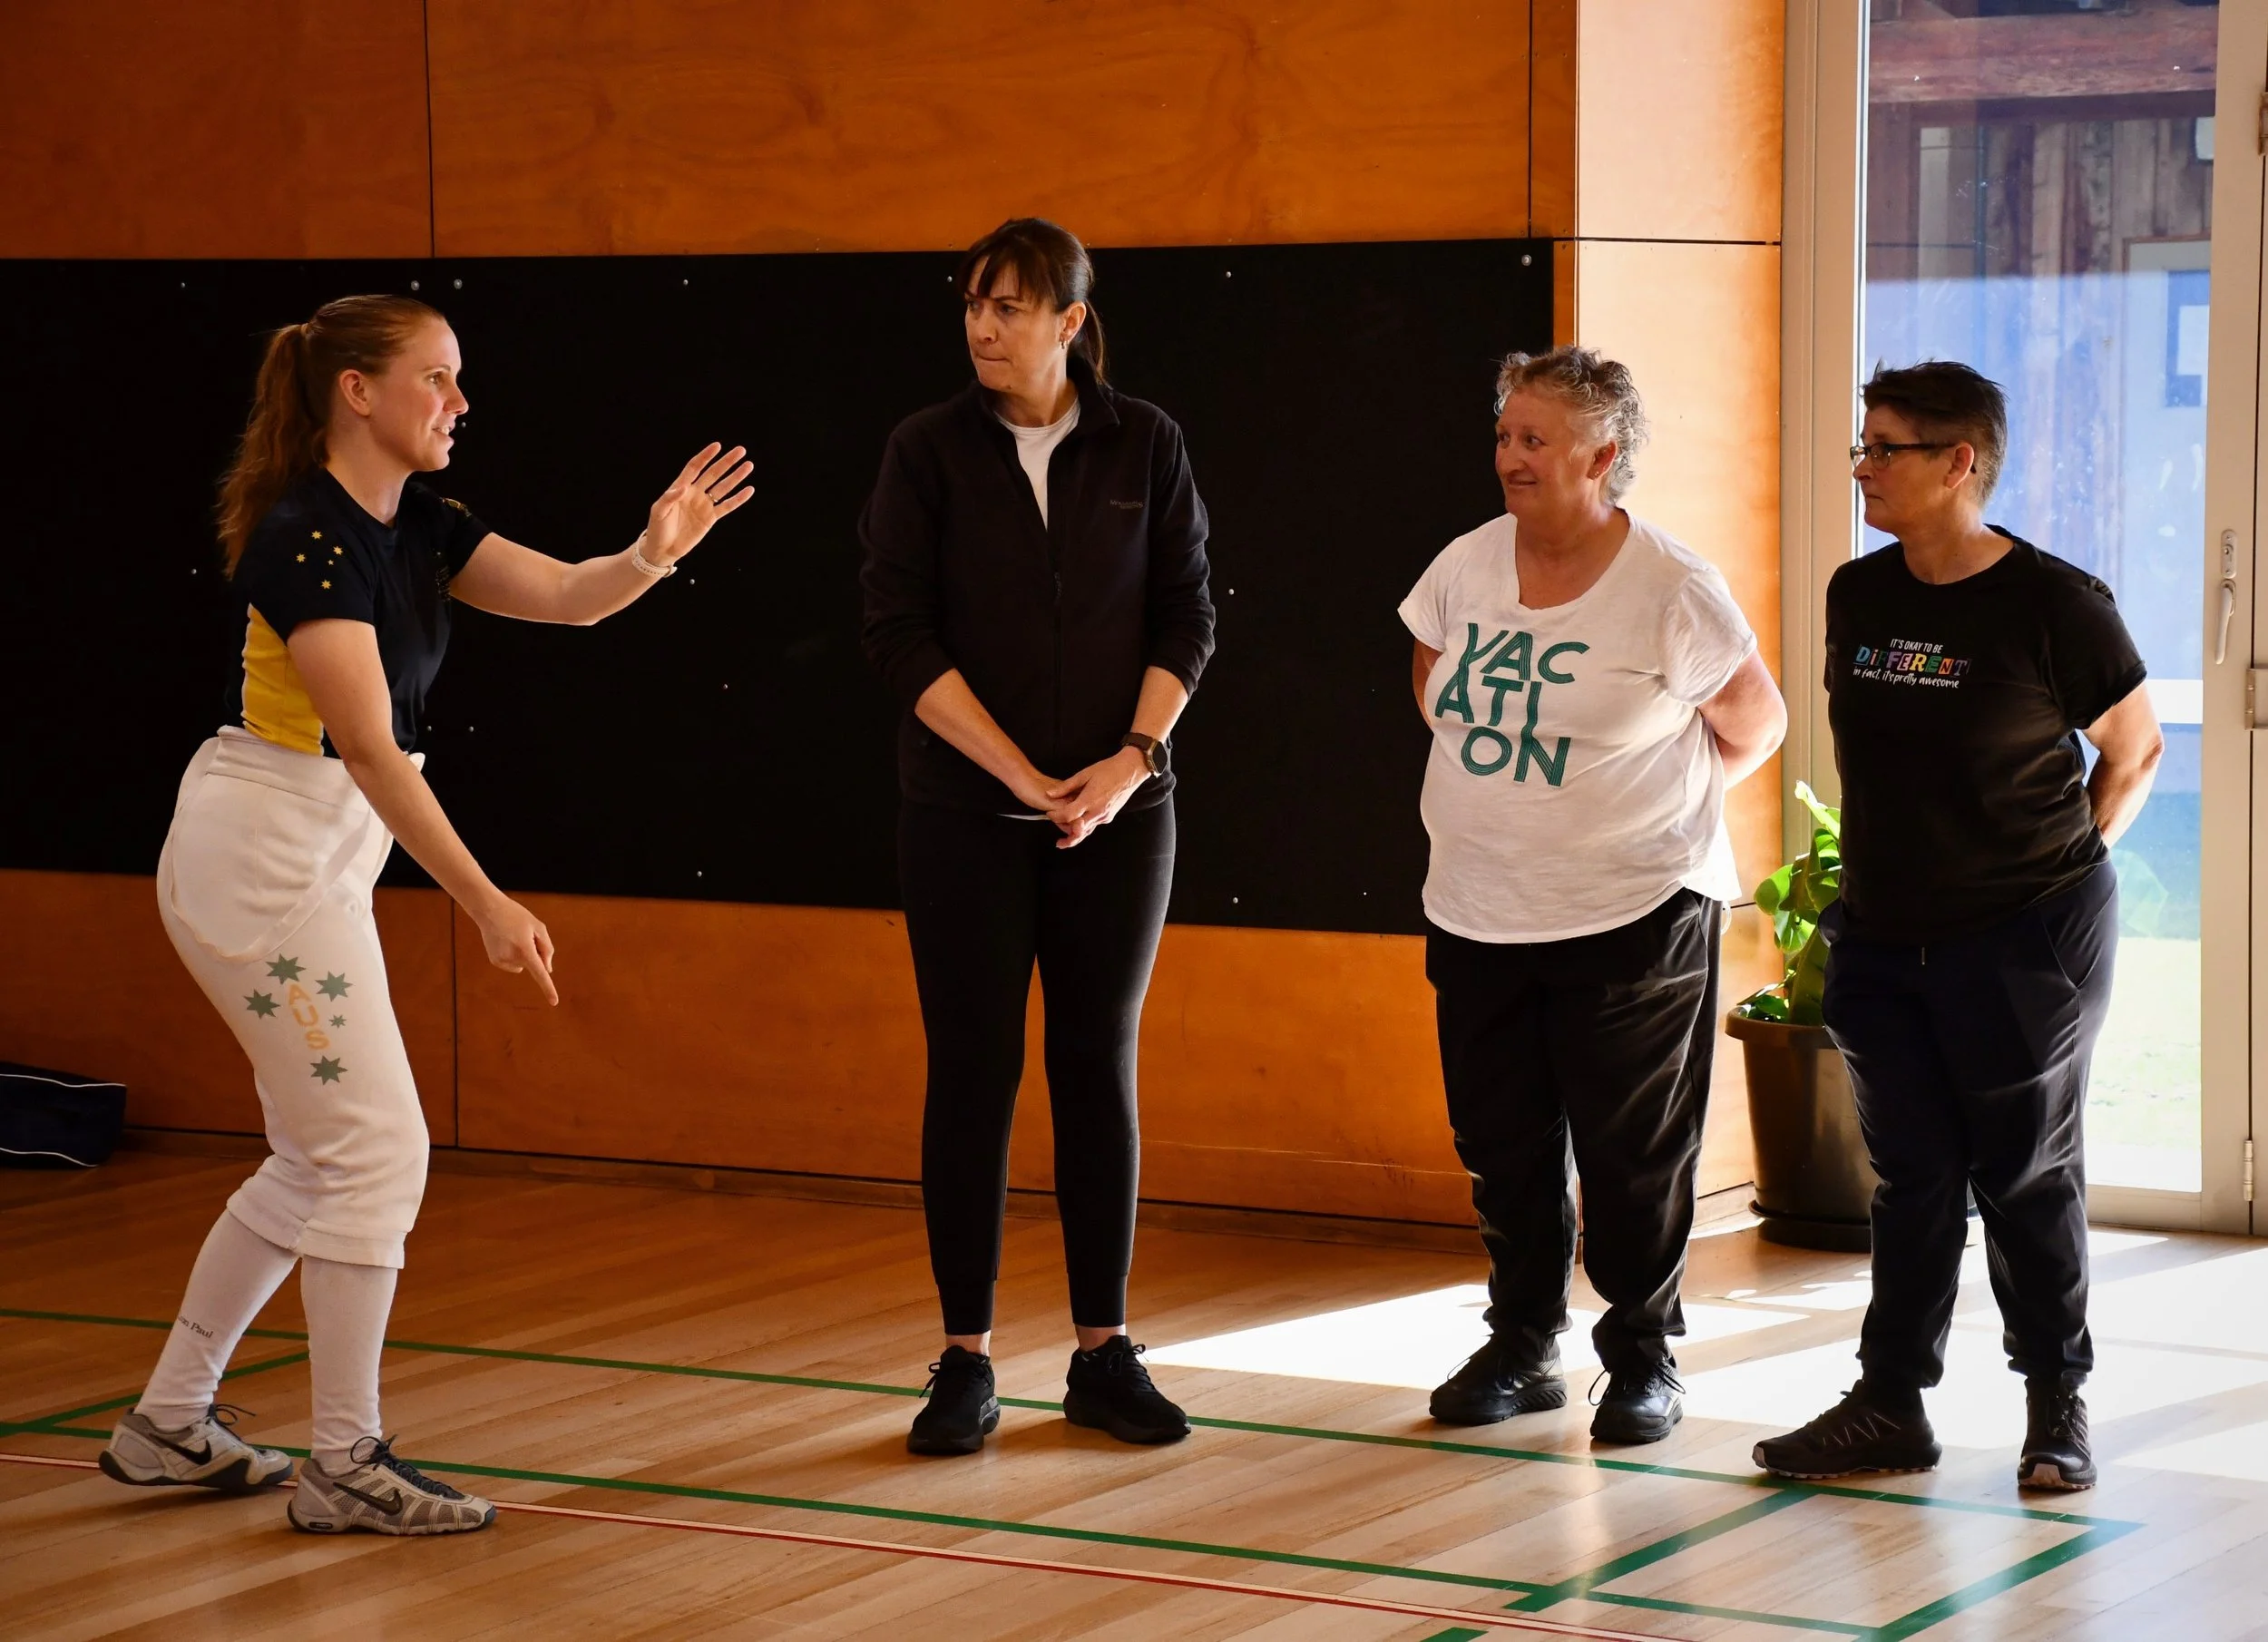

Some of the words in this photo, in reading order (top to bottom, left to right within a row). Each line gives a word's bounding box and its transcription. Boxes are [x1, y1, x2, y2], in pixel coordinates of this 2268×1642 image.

[1459, 622, 1590, 685] VAC
[1890, 638, 1905, 650] IT'S
[1904, 640, 1923, 651] OKAY
[1923, 642, 1932, 653] TO
[1932, 643, 1944, 654] BE
[1853, 666, 1861, 677] in
[1919, 676, 1960, 689] awesome
[1461, 725, 1571, 787] ON
[288, 983, 330, 1051] AUS
[191, 1322, 214, 1339] Paul
